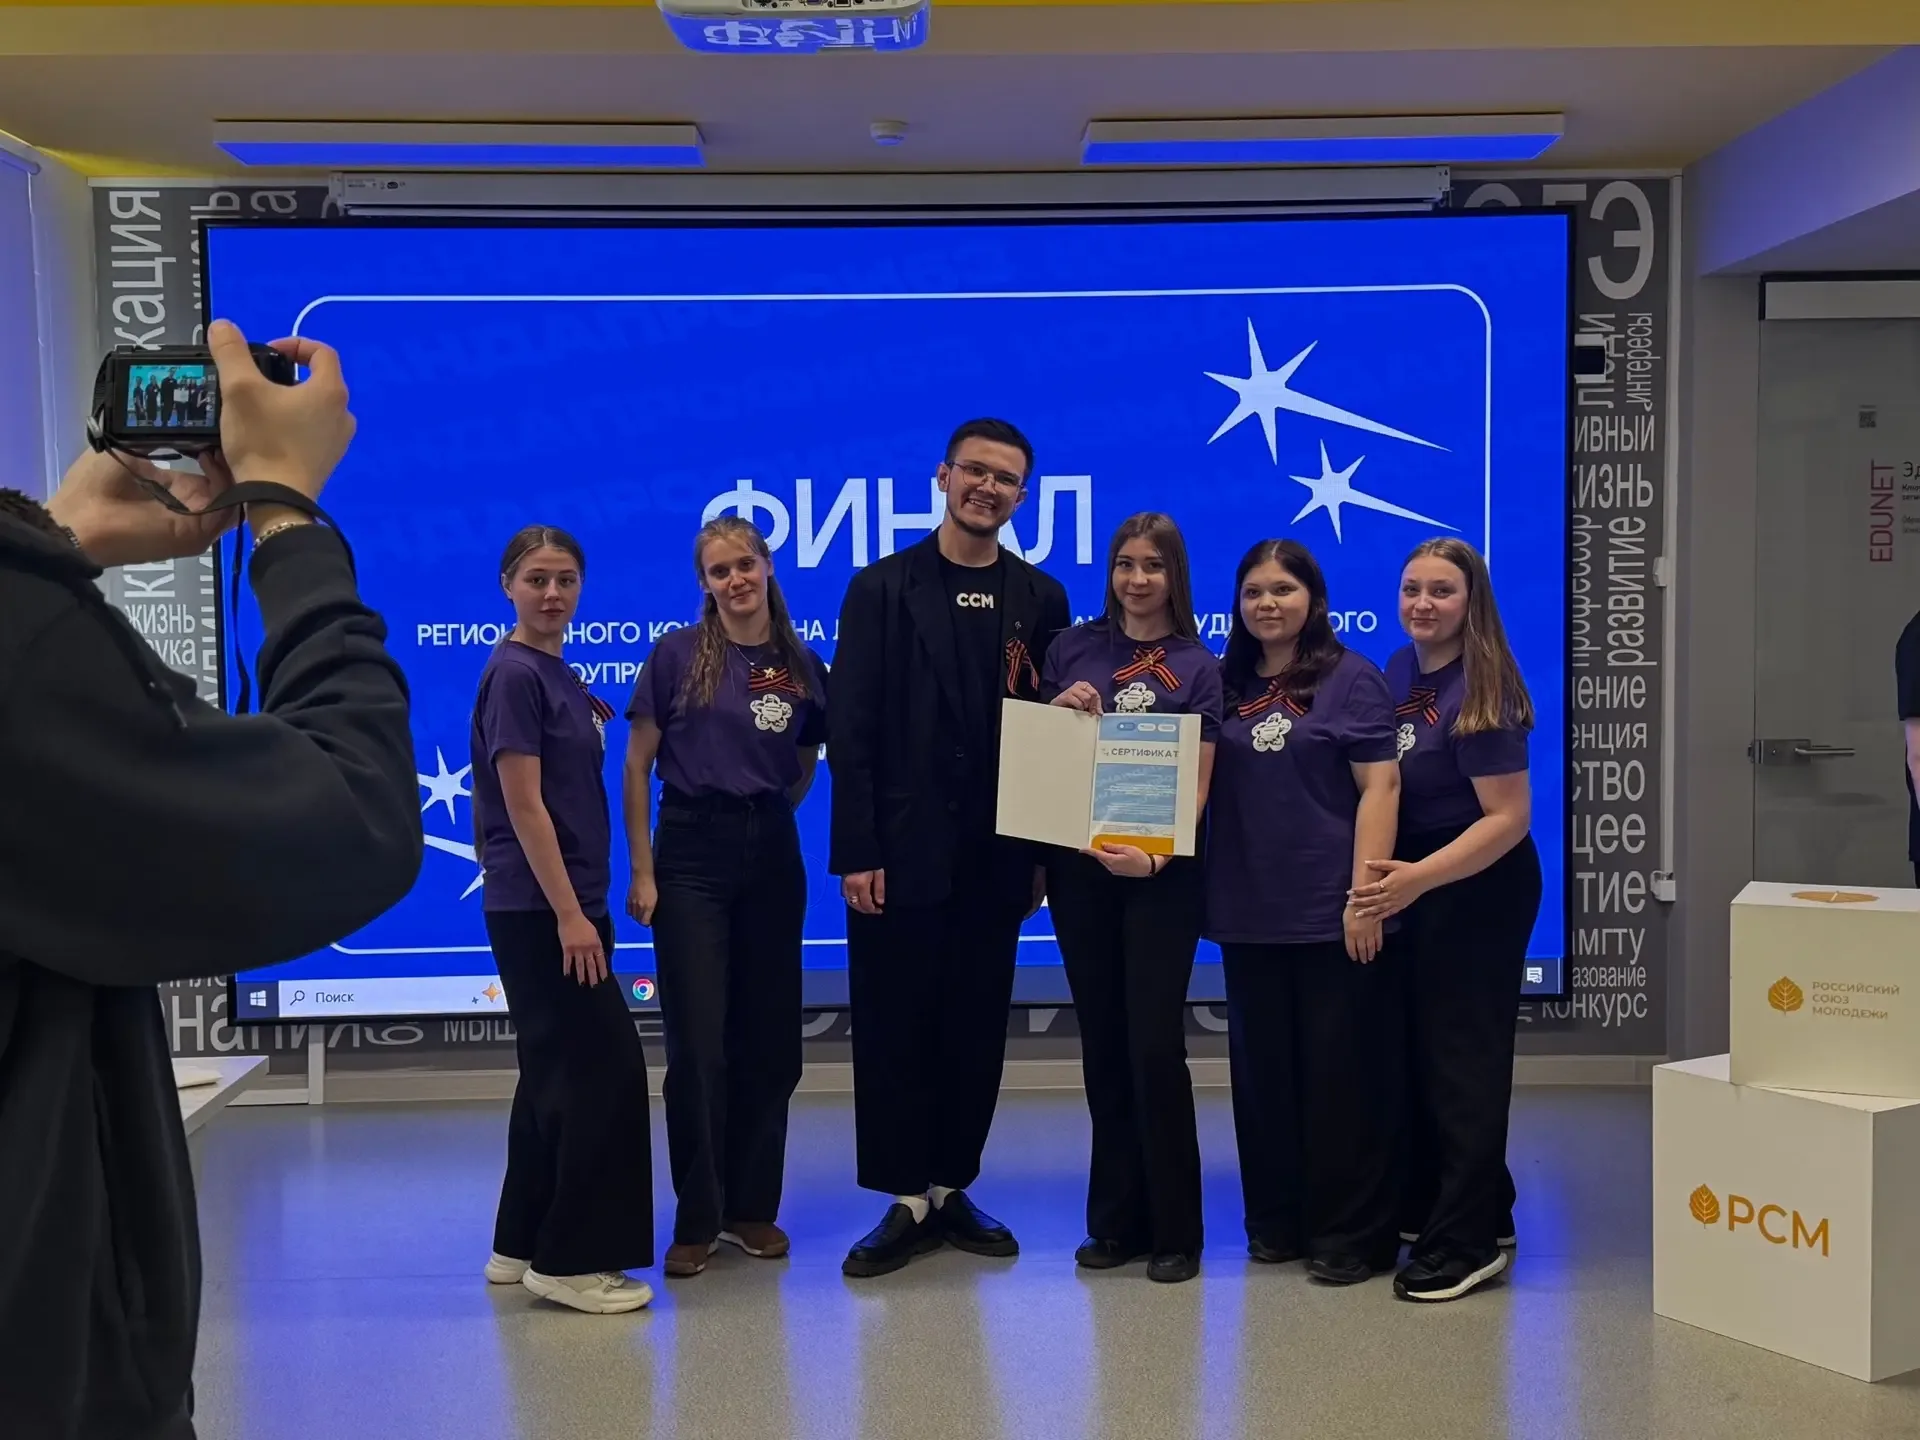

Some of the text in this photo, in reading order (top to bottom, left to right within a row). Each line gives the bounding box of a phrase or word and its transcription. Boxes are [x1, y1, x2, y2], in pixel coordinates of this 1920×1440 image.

[1626, 312, 1661, 403] интересы
[1572, 463, 1654, 509] изнь
[701, 474, 1093, 568] ФИНЛ
[1870, 459, 1895, 562] EDUNET
[1606, 516, 1658, 666] развитие
[1572, 674, 1647, 710] ение
[1111, 747, 1180, 759] СЕРТИФИКАТ
[1573, 928, 1646, 965] мгту
[315, 992, 355, 1003] Поиск
[1812, 981, 1900, 996] РОССИЙСКИЙ
[1812, 994, 1850, 1005] СОЮЗ
[1812, 1006, 1889, 1020] МОЛОДЕЖИ
[1728, 1193, 1829, 1258] РСМ
